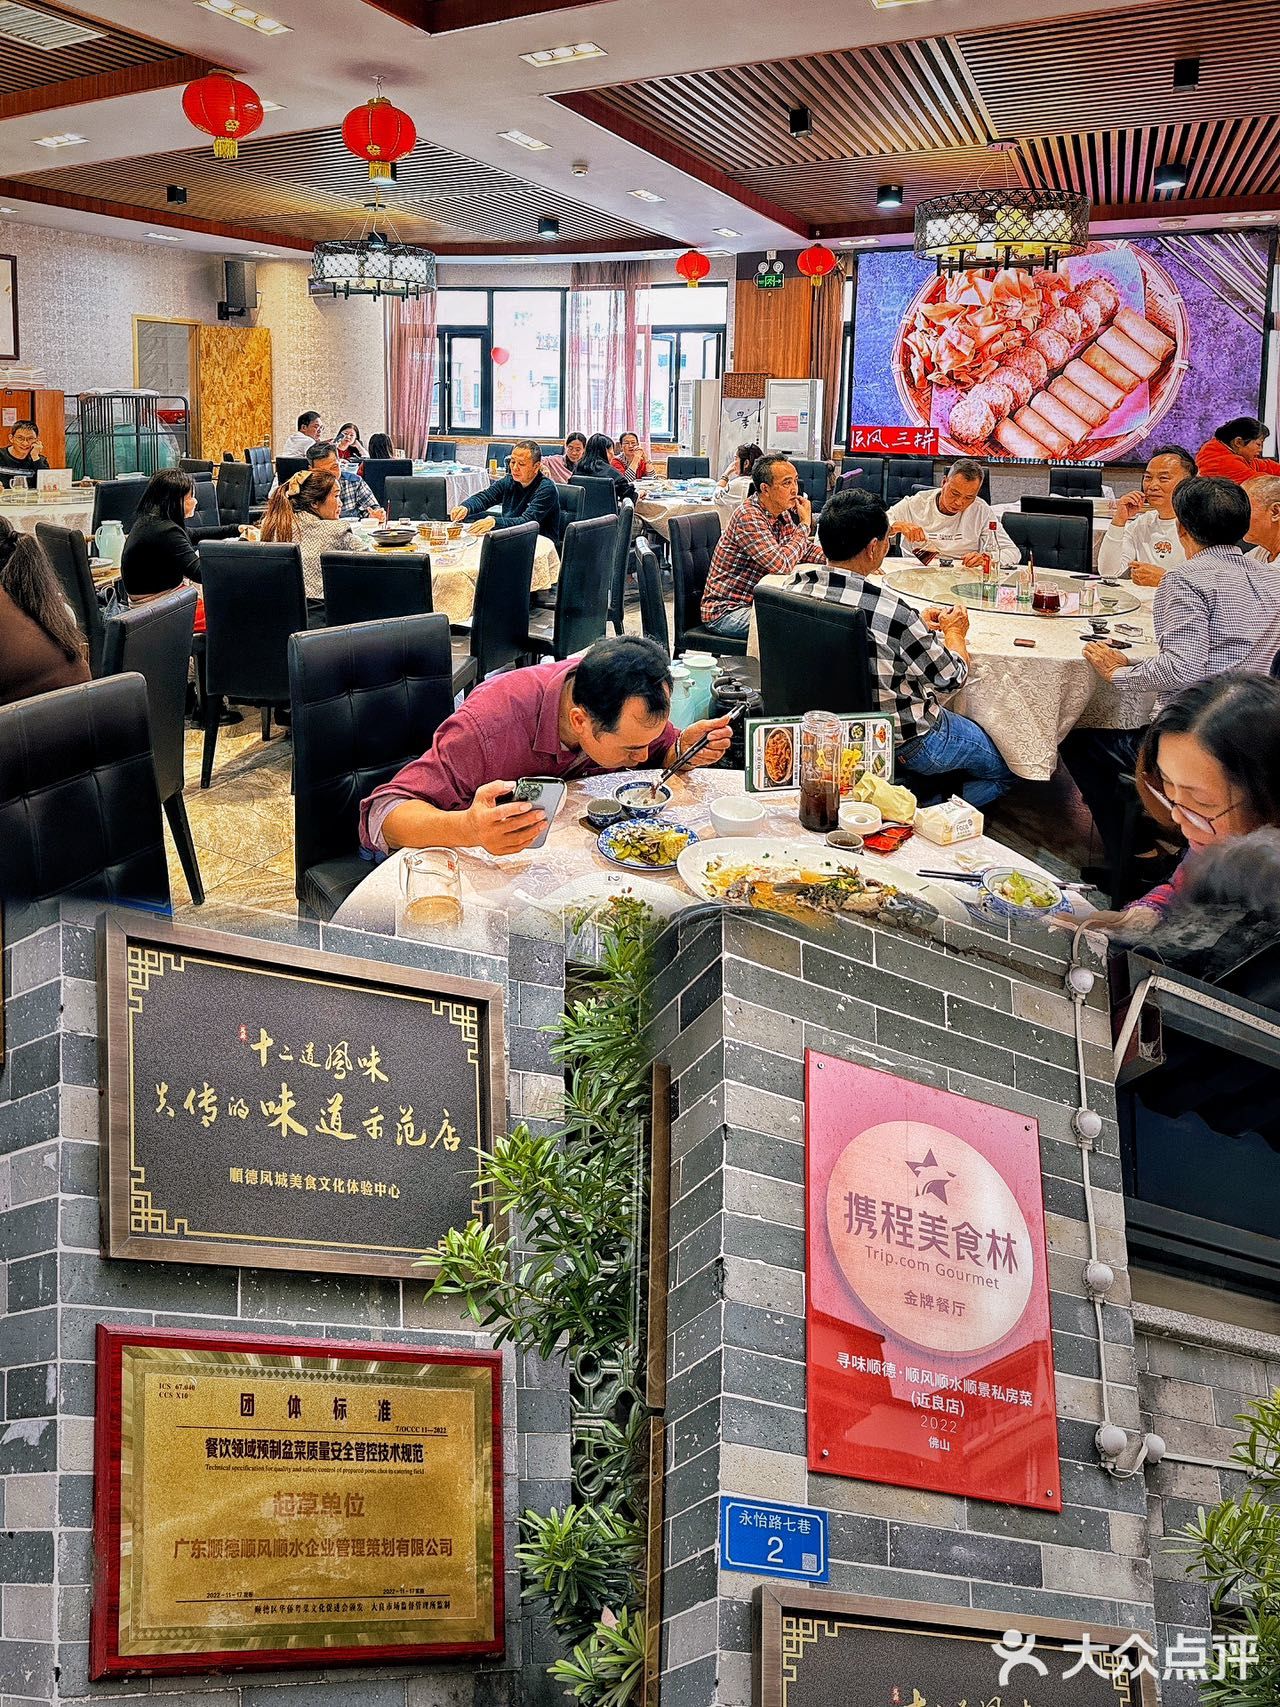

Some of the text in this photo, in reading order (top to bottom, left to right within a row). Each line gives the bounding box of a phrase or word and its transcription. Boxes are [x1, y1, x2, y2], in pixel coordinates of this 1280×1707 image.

[843, 1191, 1019, 1275] 携程美食林
[865, 1245, 1000, 1290] Trip.com Gourmet
[903, 1289, 967, 1317] 金牌餐厅
[920, 1414, 959, 1435] 2022
[205, 1437, 425, 1463] 餐饮领域预制盆菜质量安全管控技术规范
[928, 1436, 951, 1452] 佛山
[272, 1490, 366, 1519] 起草单位
[739, 1509, 811, 1535] 永怡路七巷
[173, 1537, 453, 1560] 广东顺德顺风顺水企业管理策划有限公司
[767, 1536, 784, 1563] 2
